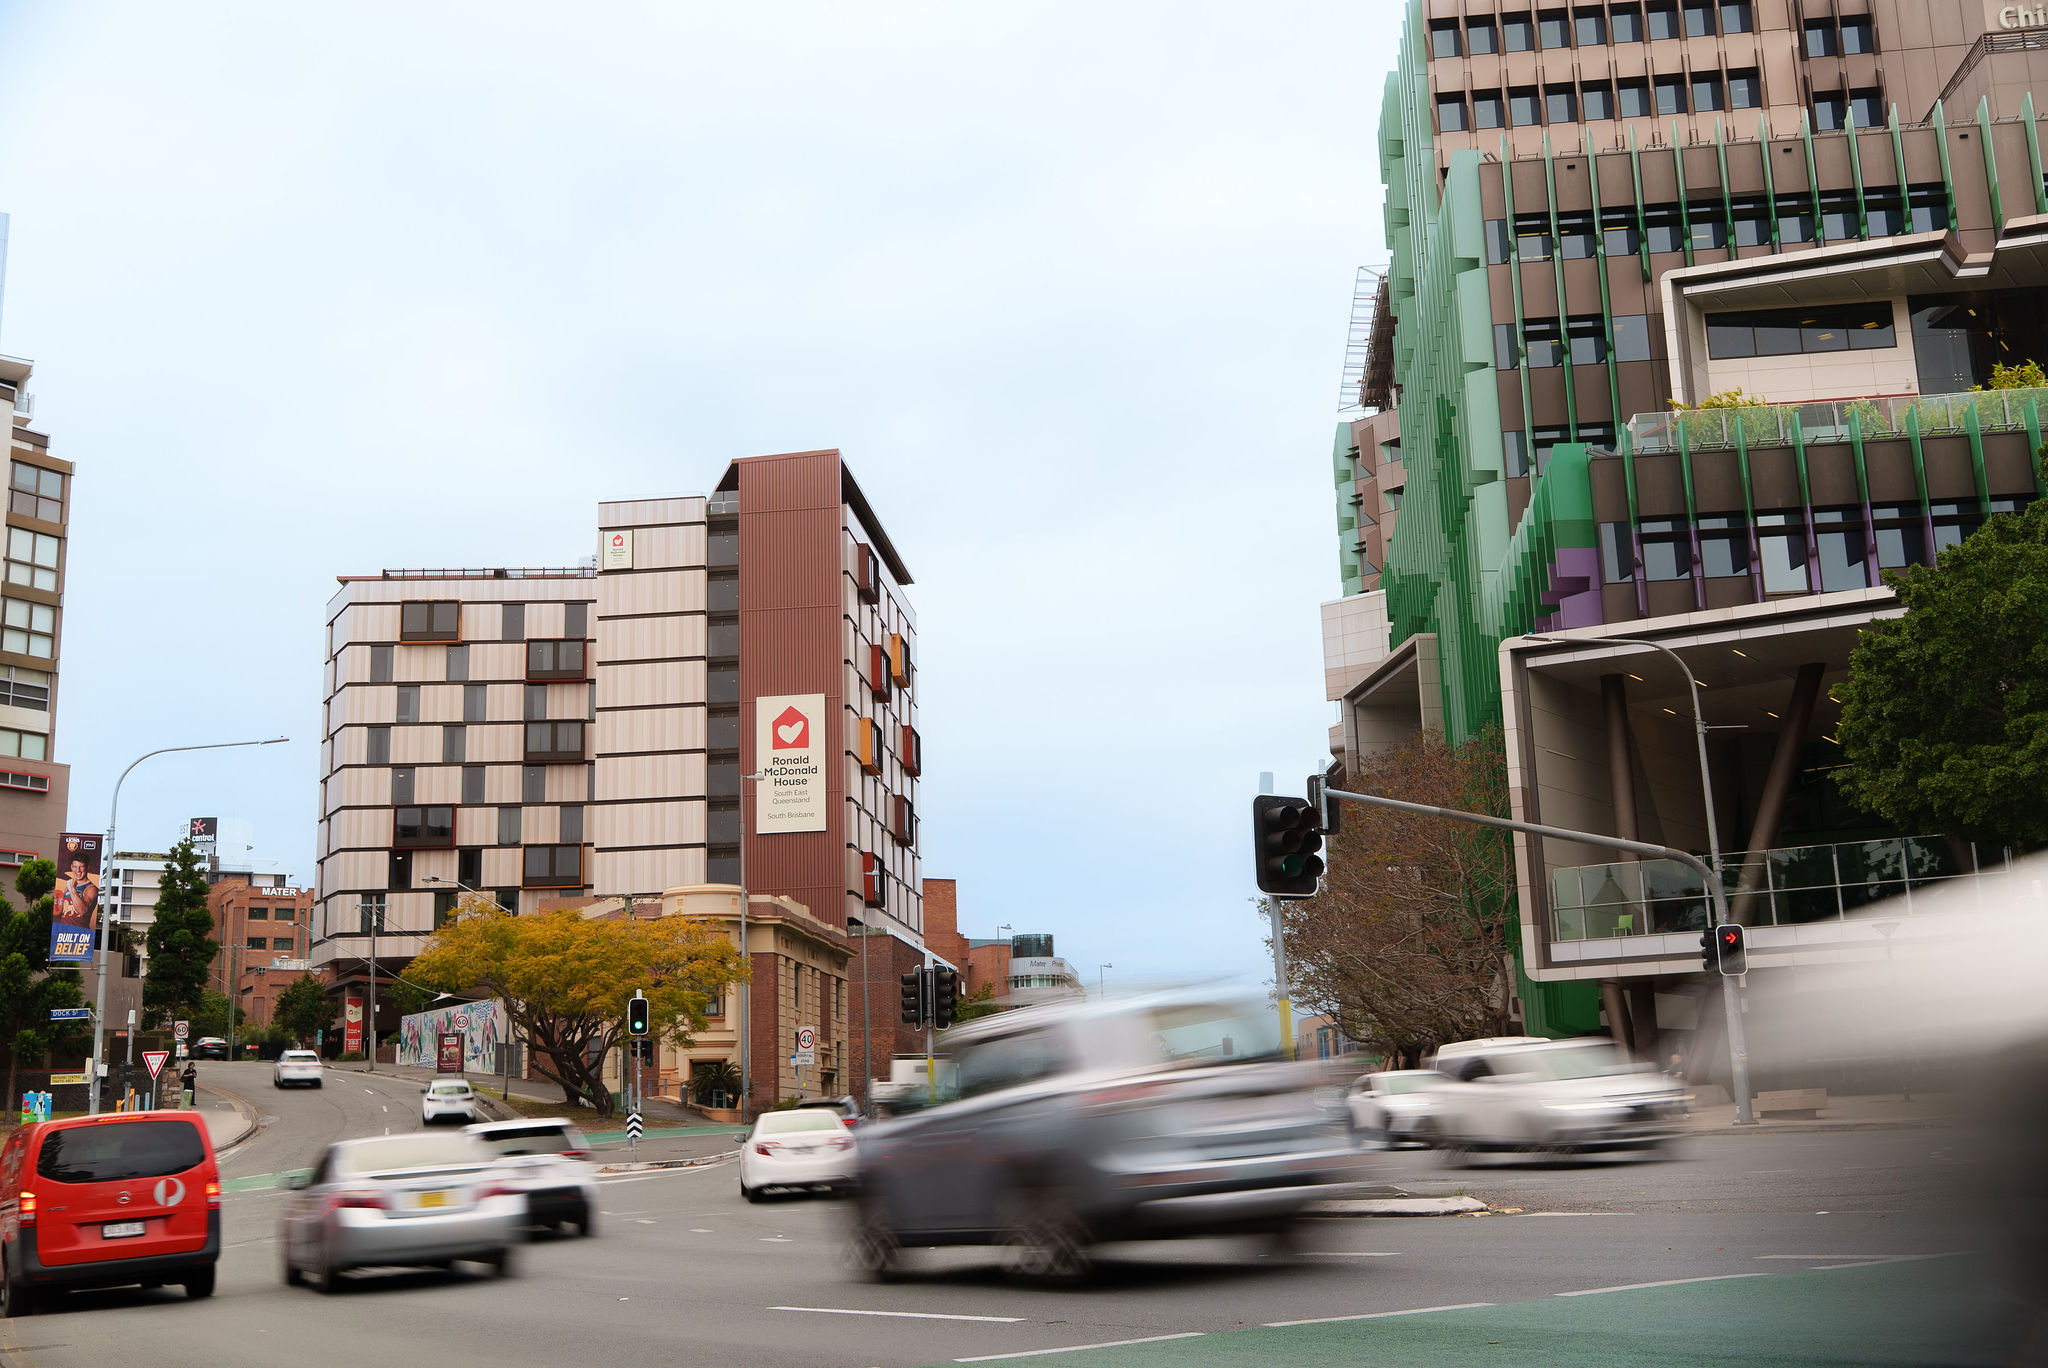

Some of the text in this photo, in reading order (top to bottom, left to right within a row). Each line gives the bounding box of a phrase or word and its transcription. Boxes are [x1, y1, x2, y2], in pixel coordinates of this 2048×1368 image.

[1999, 3, 2048, 29] Chi
[772, 756, 809, 766] Ronald
[764, 766, 818, 776] McDonald
[774, 778, 808, 786] House
[191, 833, 215, 842] central
[261, 887, 297, 897] MATER
[57, 932, 91, 943] BUILT ON
[54, 942, 90, 956] BELIEF
[1029, 960, 1047, 968] Mater
[52, 1009, 71, 1017] DOCK
[802, 1035, 812, 1044] 40
